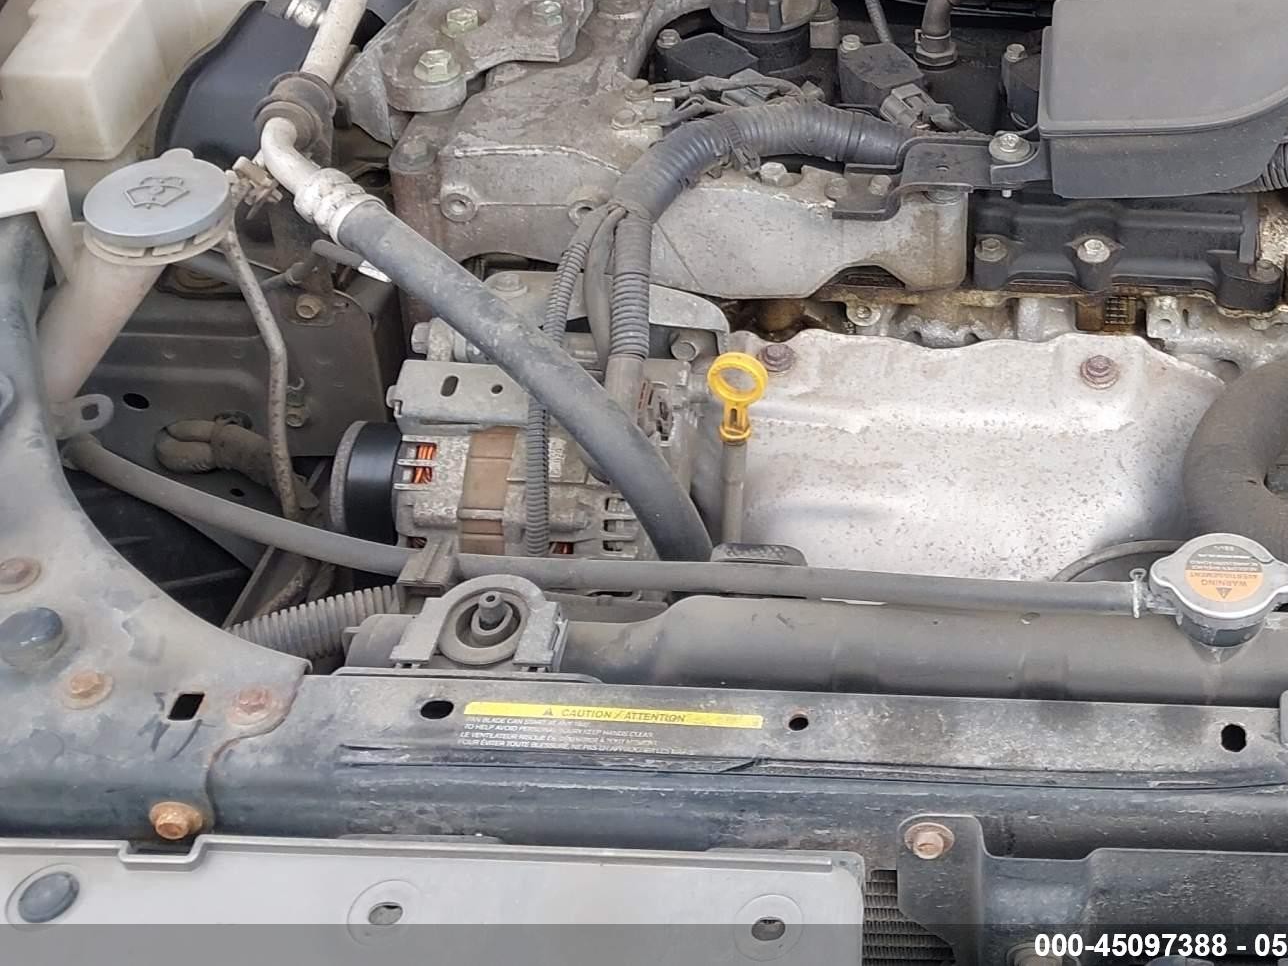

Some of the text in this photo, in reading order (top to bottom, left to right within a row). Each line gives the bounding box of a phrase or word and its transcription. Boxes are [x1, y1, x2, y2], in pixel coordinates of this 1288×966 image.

[1200, 578, 1248, 587] WARNING
[561, 708, 613, 719] CAUTION
[623, 712, 686, 723] ATTENTION
